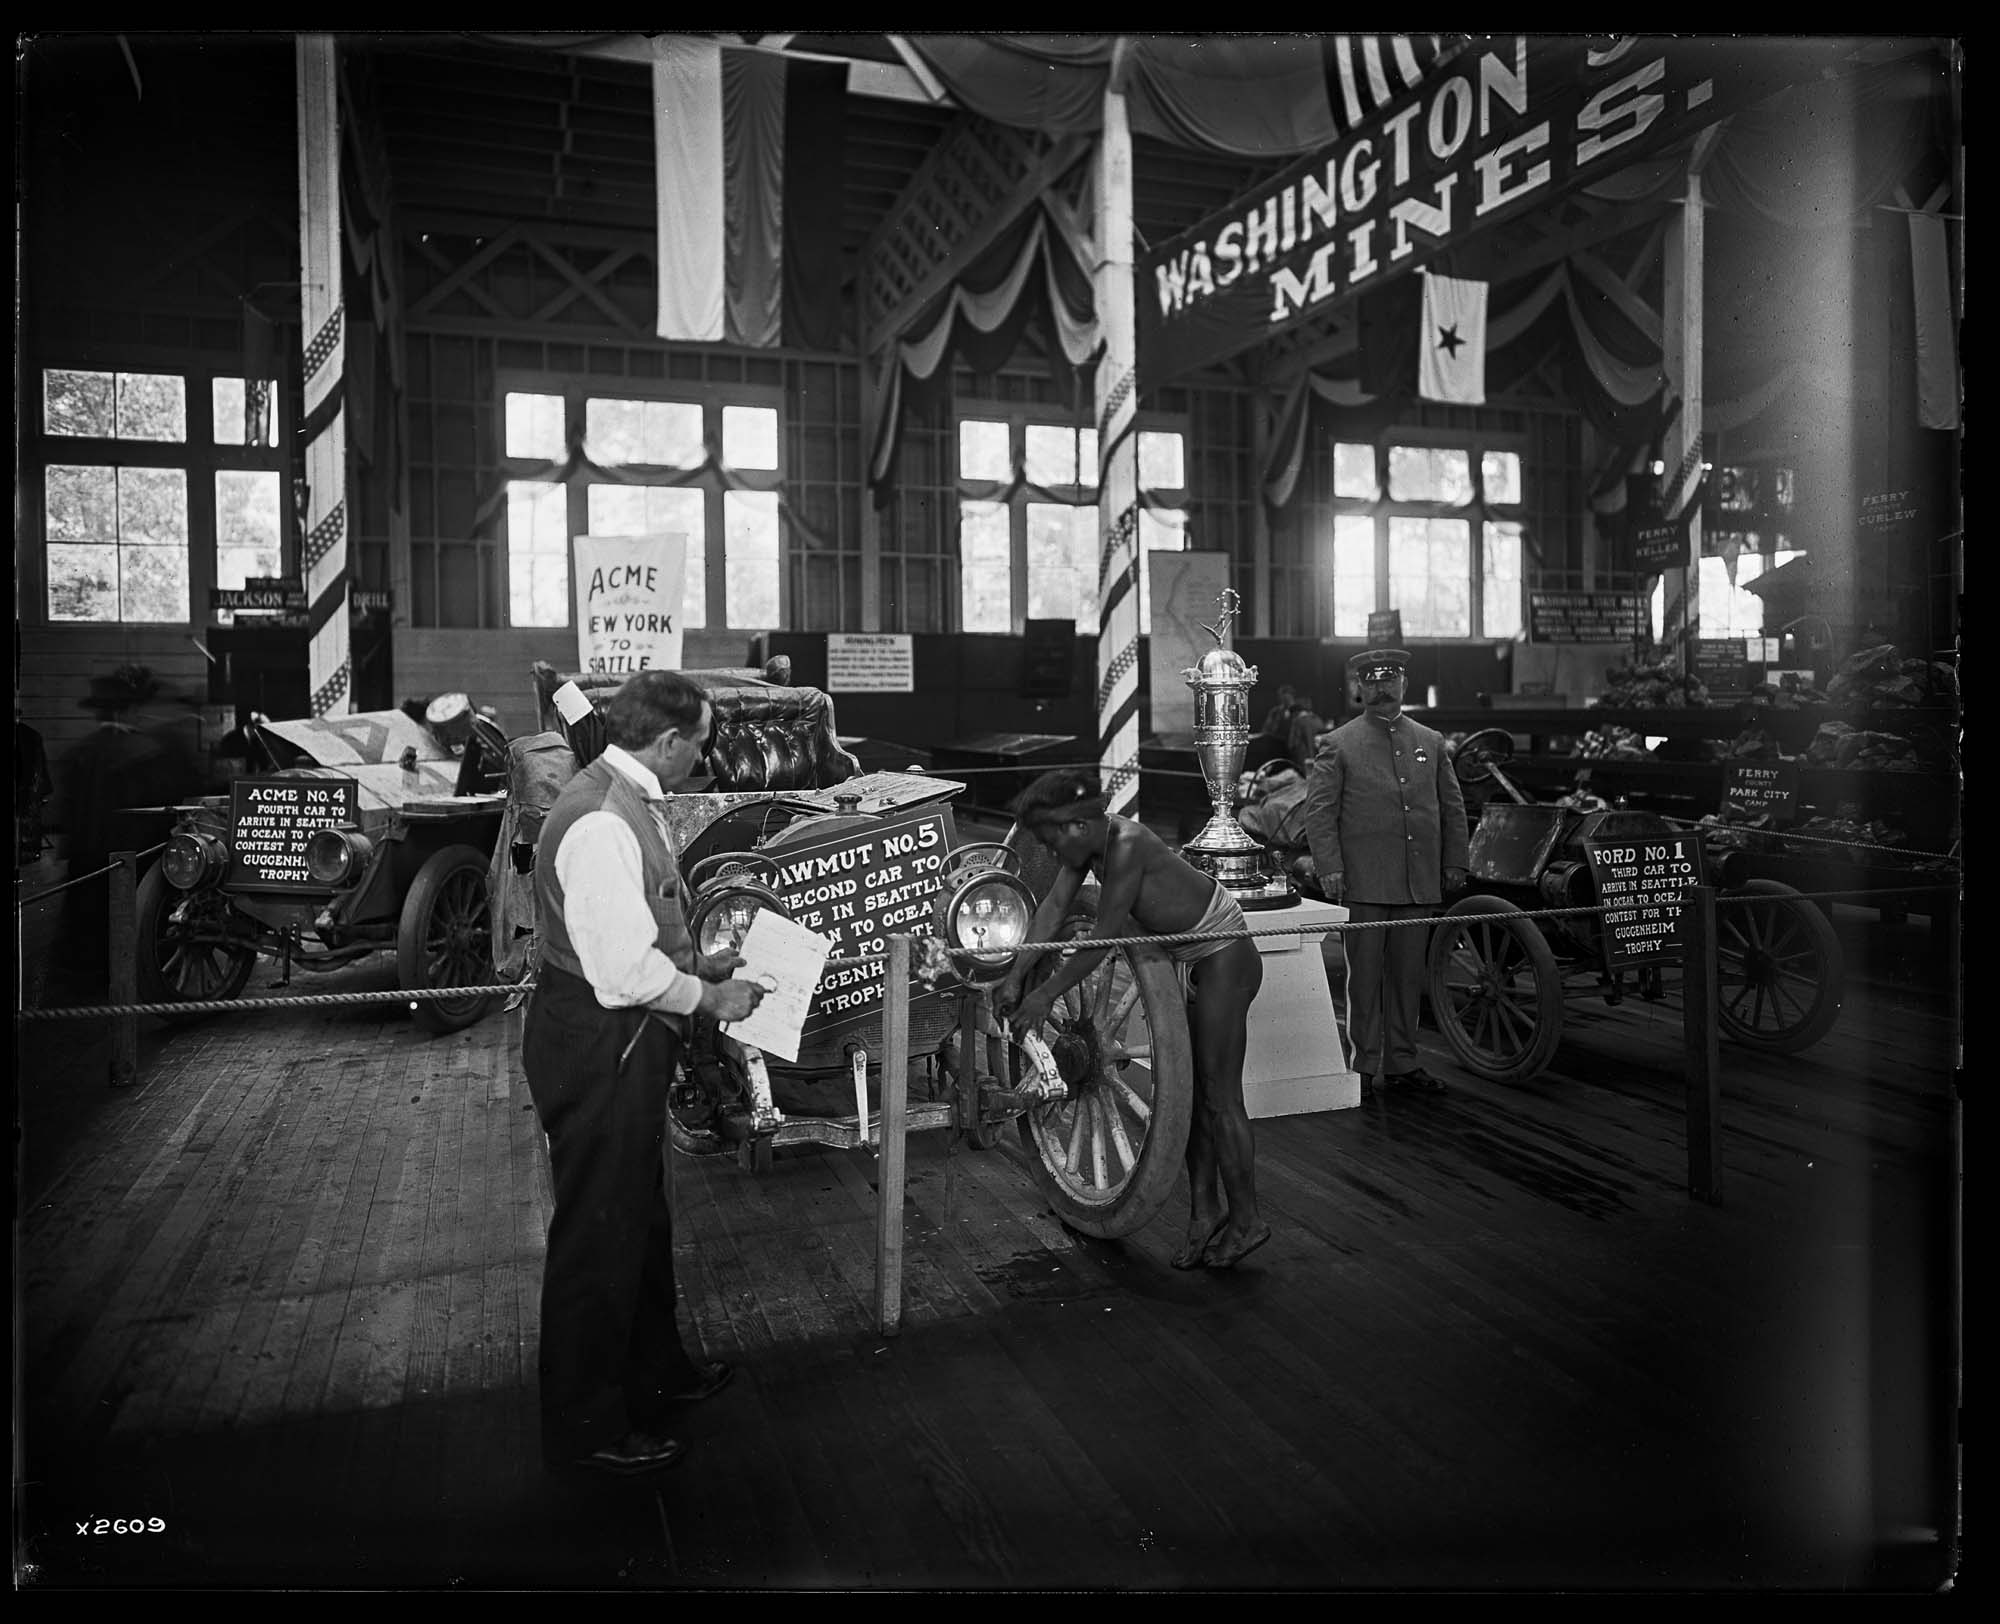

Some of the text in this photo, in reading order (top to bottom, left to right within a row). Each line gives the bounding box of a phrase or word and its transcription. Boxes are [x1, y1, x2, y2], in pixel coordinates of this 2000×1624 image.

[1270, 56, 1713, 322] MINES.
[589, 565, 658, 602] ACME
[217, 591, 283, 608] JACKSON
[589, 614, 672, 634] EW YORK
[609, 639, 631, 651] TO
[1738, 768, 1779, 779] FERRY
[248, 788, 298, 802] ACME
[1729, 787, 1790, 800] PARK CITY
[257, 804, 346, 817] FOURTH CAR TO
[1744, 799, 1768, 807] CAMP
[238, 816, 276, 827] ARRIVE
[280, 817, 291, 827] IN
[236, 828, 248, 838] IN
[251, 829, 286, 839] OCEAN
[290, 830, 304, 840] TO
[235, 841, 307, 852] CONTEST FO
[243, 854, 306, 867] GUGGENH
[1593, 848, 1636, 865] FORD
[760, 843, 872, 889] AWMUT
[865, 865, 903, 889] CAR
[912, 855, 940, 874] TO
[1611, 862, 1692, 878] THIRD CAR TO
[259, 868, 309, 881] TROPHY
[1601, 876, 1698, 894] ARRIVE IN SEATTLE
[1603, 891, 1682, 908] IN OCEAN TO OCE
[832, 901, 855, 921] IN
[850, 918, 874, 937] TO
[882, 898, 936, 927] OCEA
[1605, 910, 1638, 924] CONTEST
[1642, 908, 1660, 919] FOR
[1615, 922, 1675, 939] GUGGENHEIM
[858, 937, 885, 957] FO
[1625, 939, 1662, 954] TROPHY
[820, 982, 885, 1015] TROPH
